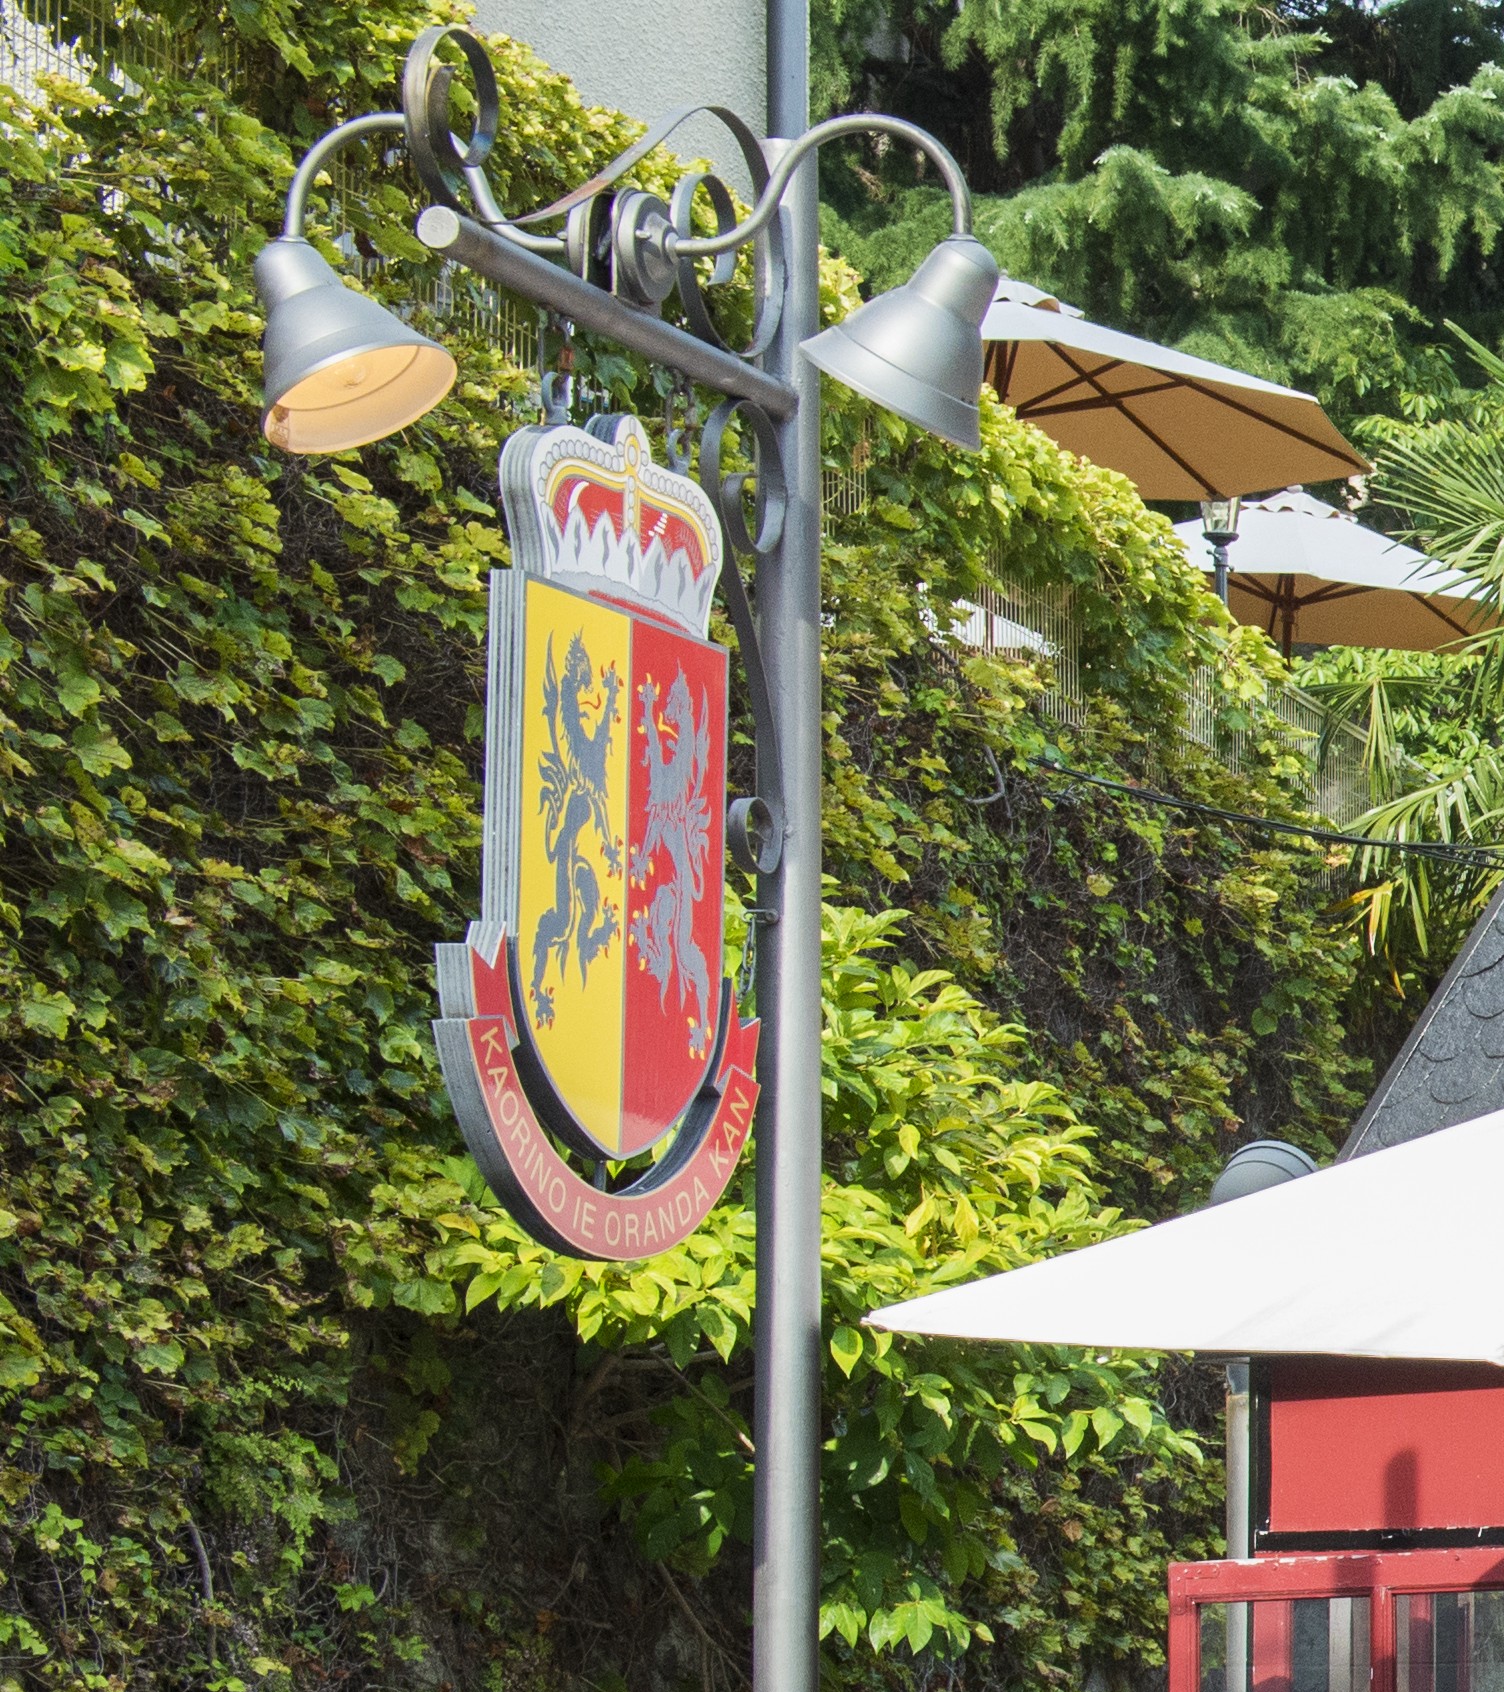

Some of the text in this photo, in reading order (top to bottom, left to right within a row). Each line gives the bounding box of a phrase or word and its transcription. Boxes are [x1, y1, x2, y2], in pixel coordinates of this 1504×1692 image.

[480, 1026, 751, 1248] KAORINO IE ORANDA KAN
